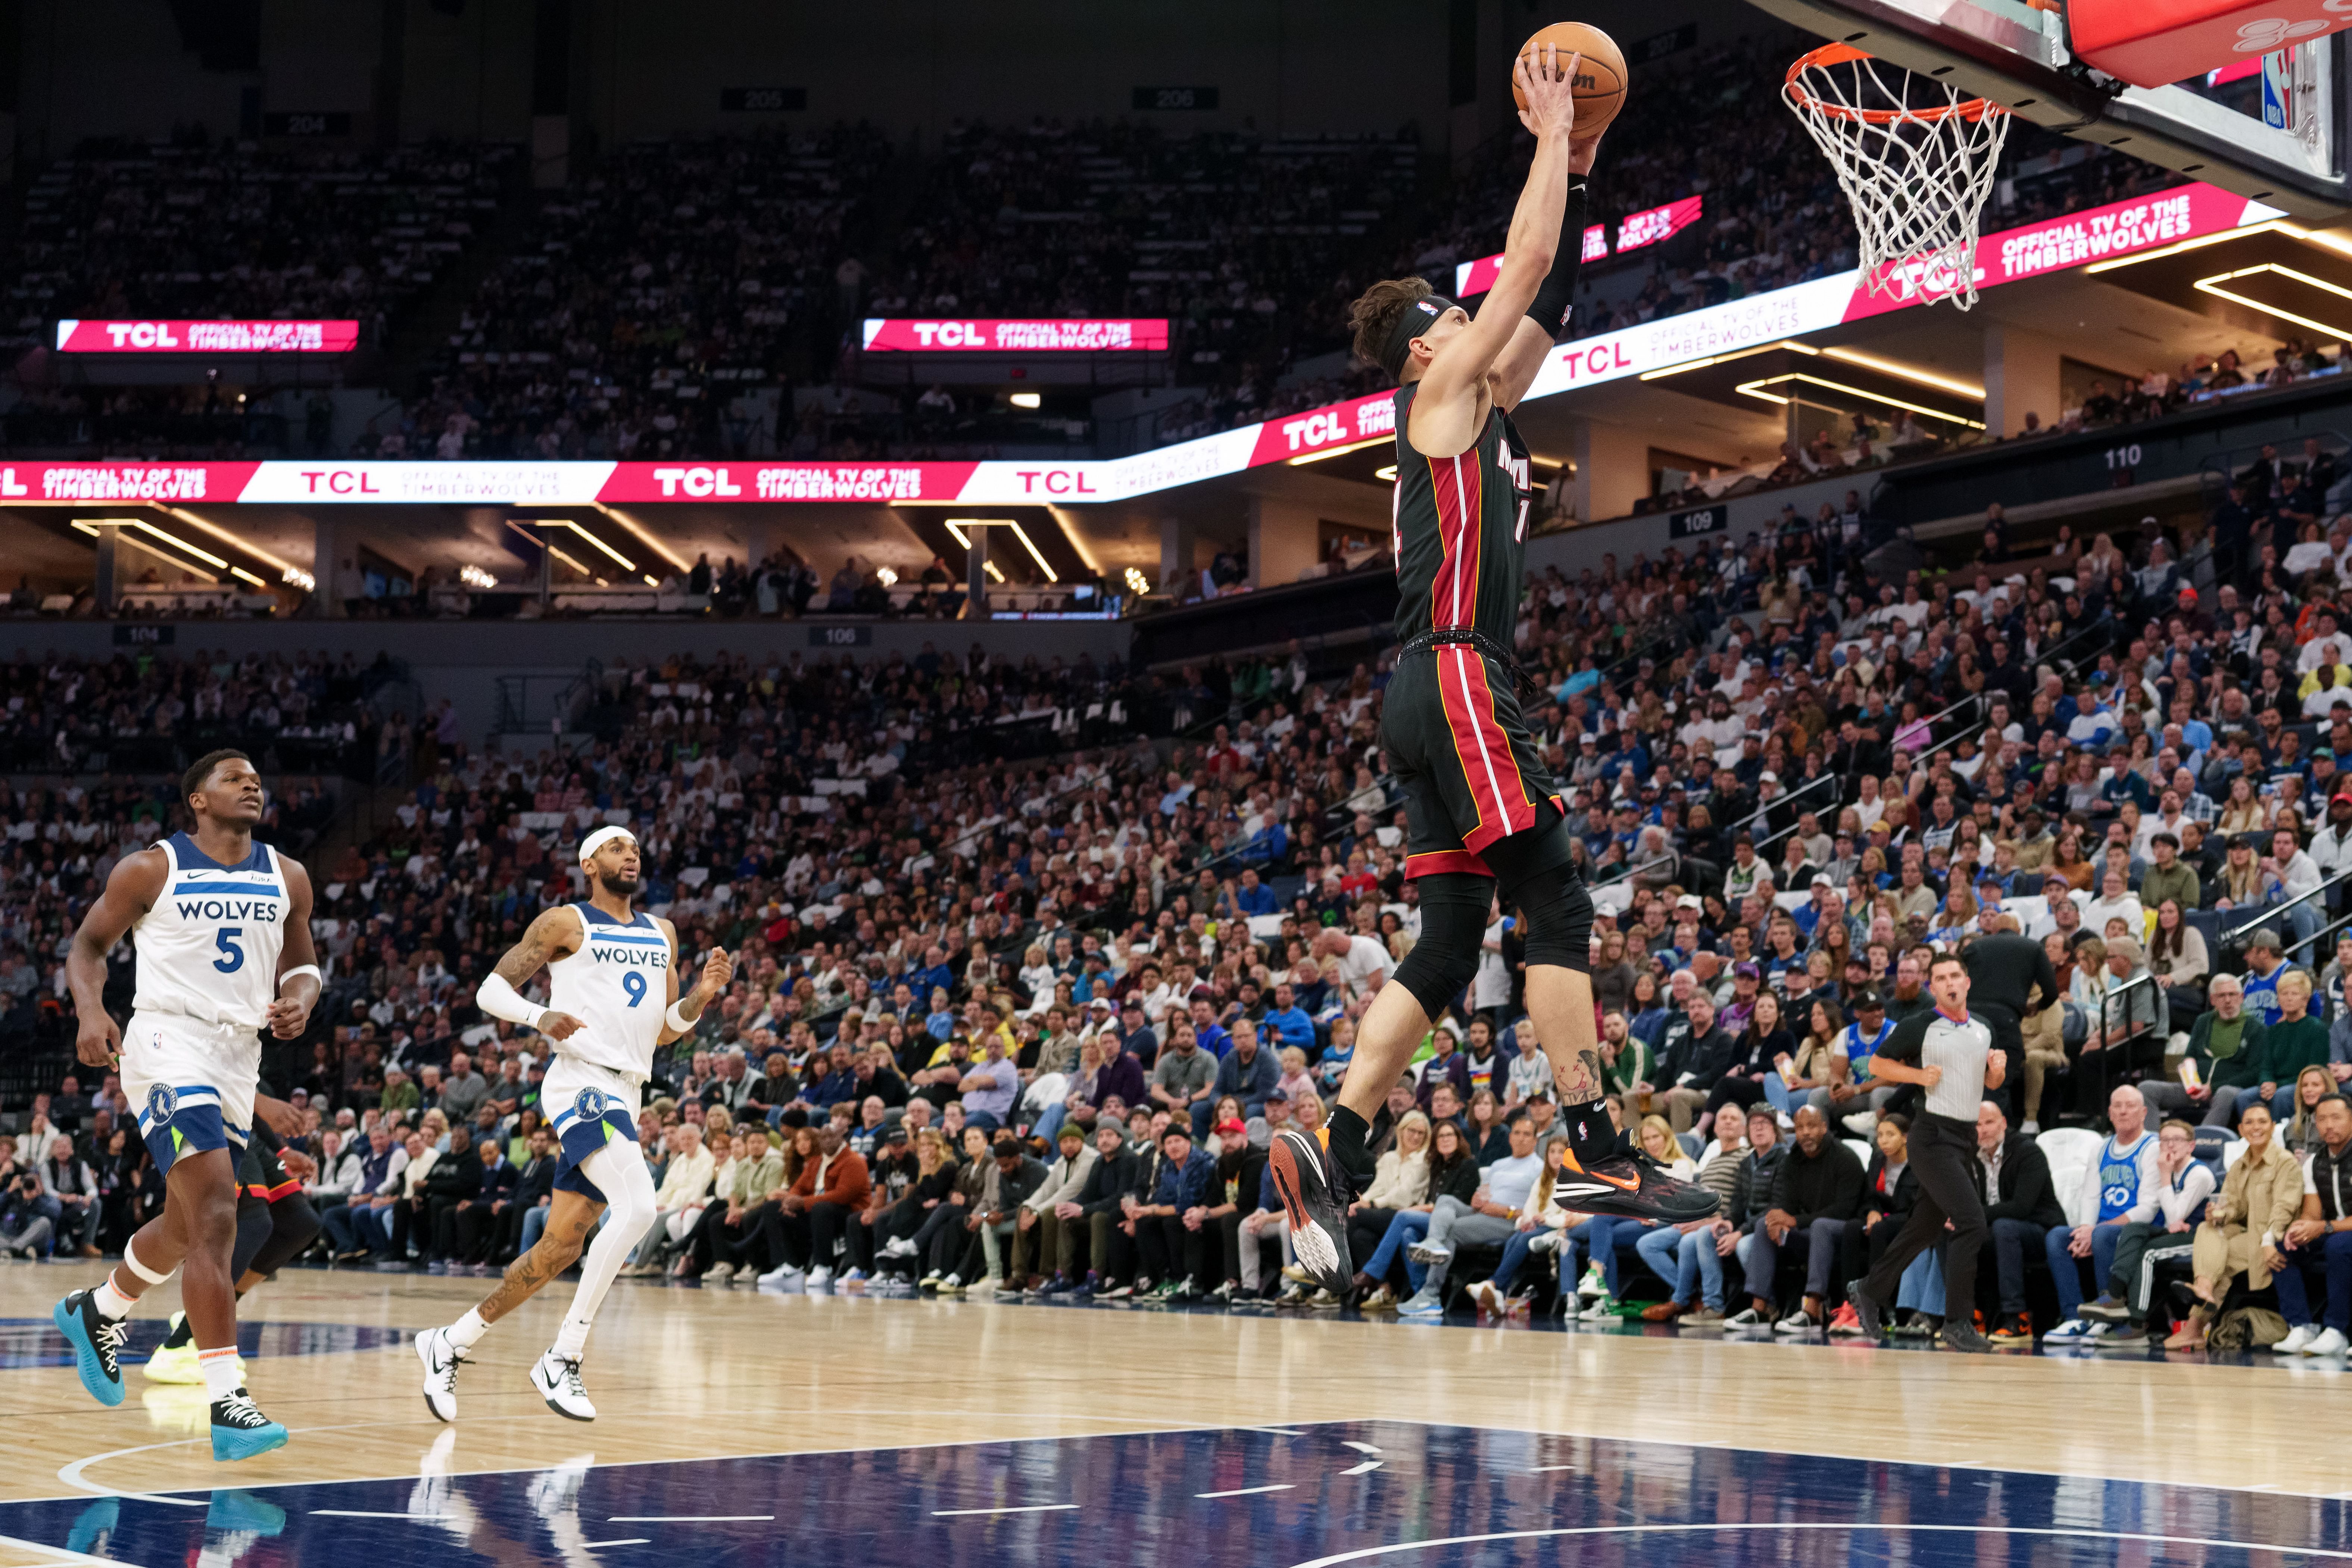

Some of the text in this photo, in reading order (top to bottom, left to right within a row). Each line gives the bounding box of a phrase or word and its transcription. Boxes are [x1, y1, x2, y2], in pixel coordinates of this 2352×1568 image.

[1157, 89, 1195, 107] 206
[288, 115, 325, 134] 204
[2002, 194, 2190, 257] OFFICIAL TV OF THE
[2001, 213, 2191, 276] TIMBERWOLVES
[106, 322, 178, 348] TCL
[253, 324, 272, 336] TV
[914, 322, 986, 349] TCL
[996, 323, 1131, 335] OFFICIAL TV OF THE
[996, 334, 1132, 348] TIMBERWOLVES
[1563, 341, 1631, 379] TCL
[1282, 411, 1347, 450] TCL
[2105, 443, 2142, 470] 110
[44, 468, 119, 483] OFFICIAL
[122, 468, 145, 482] TV
[147, 468, 172, 483] OF
[174, 468, 207, 483] THE
[301, 471, 380, 493] TCL
[653, 468, 741, 497] TCL
[757, 468, 921, 483] OFFICIAL TV OF THE
[1016, 471, 1095, 493] TCL
[42, 481, 206, 499] TIMBERWOLVES
[755, 482, 921, 498] TIMBERWOLVES
[1685, 509, 1713, 532] 109
[177, 901, 277, 922] WOLVES
[213, 928, 244, 974] 5
[591, 948, 667, 969] WOLVES
[623, 971, 647, 1008] 9
